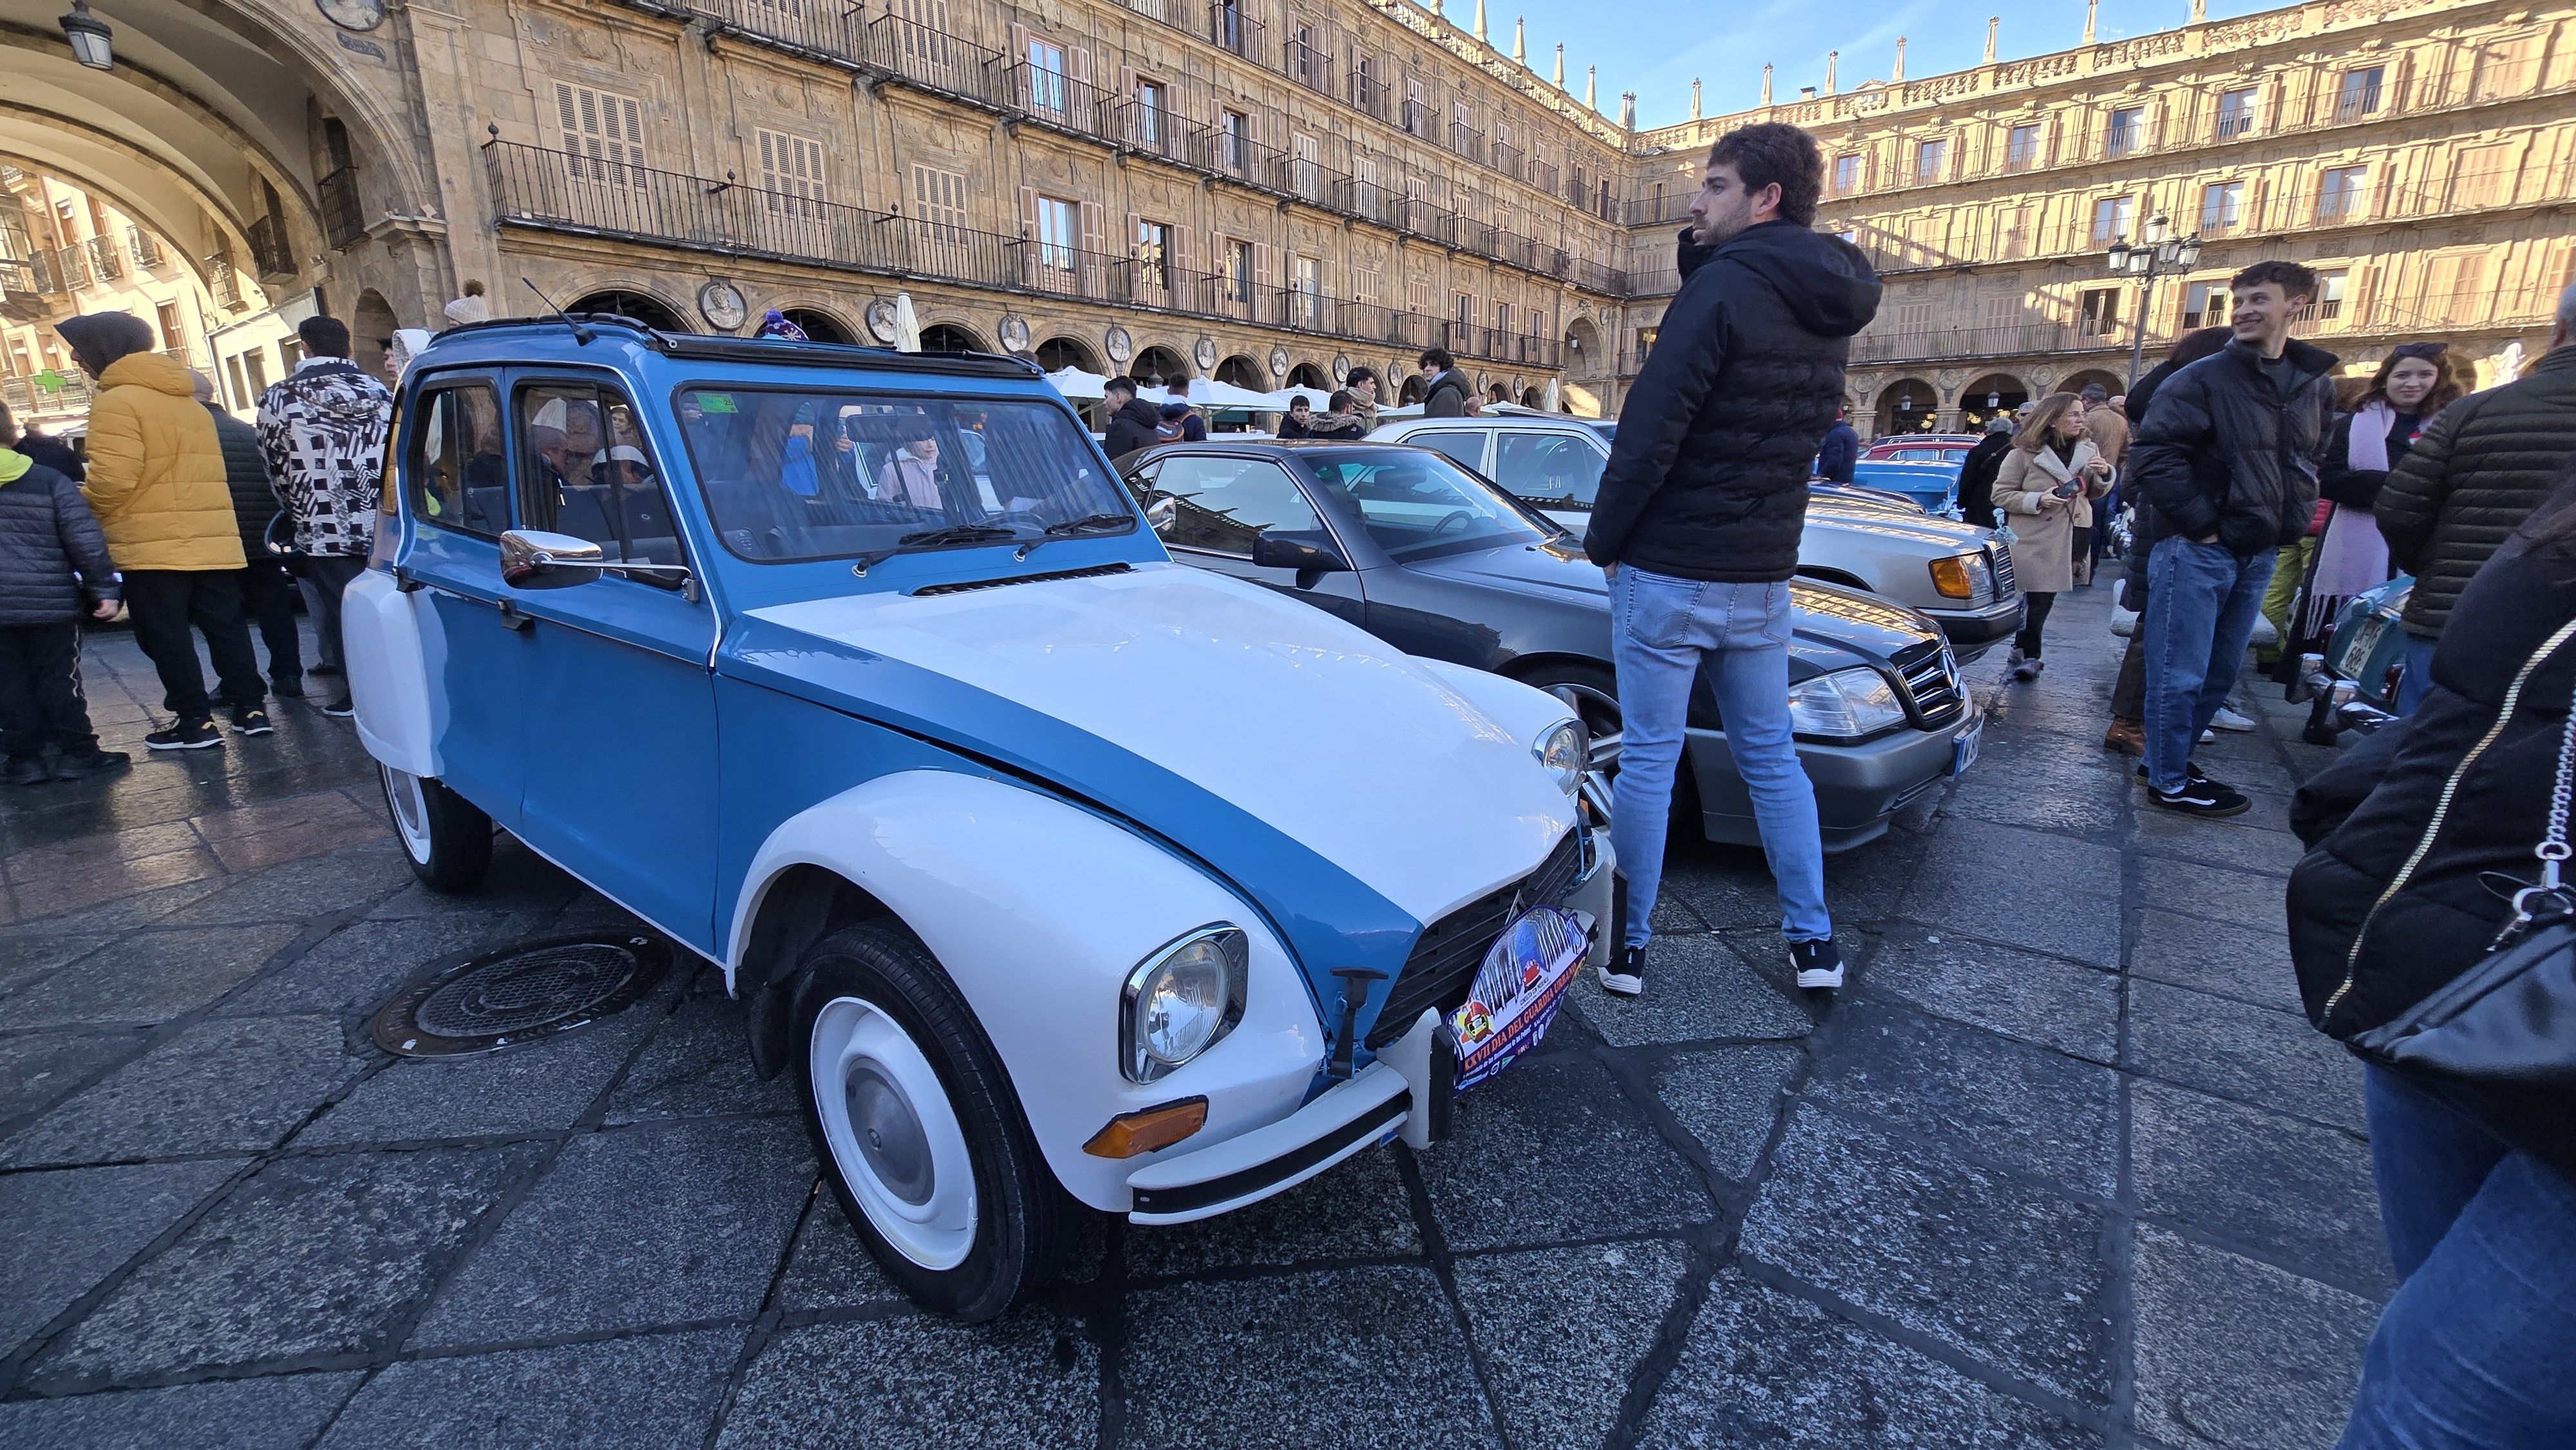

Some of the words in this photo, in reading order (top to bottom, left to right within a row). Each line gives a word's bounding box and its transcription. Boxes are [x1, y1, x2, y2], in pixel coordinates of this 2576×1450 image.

[2345, 646, 2365, 673] 686
[1492, 1031, 1507, 1052] DIA
[1508, 1017, 1524, 1039] DEL
[1524, 988, 1554, 1024] GUARDIA
[1553, 962, 1577, 993] URBANO
